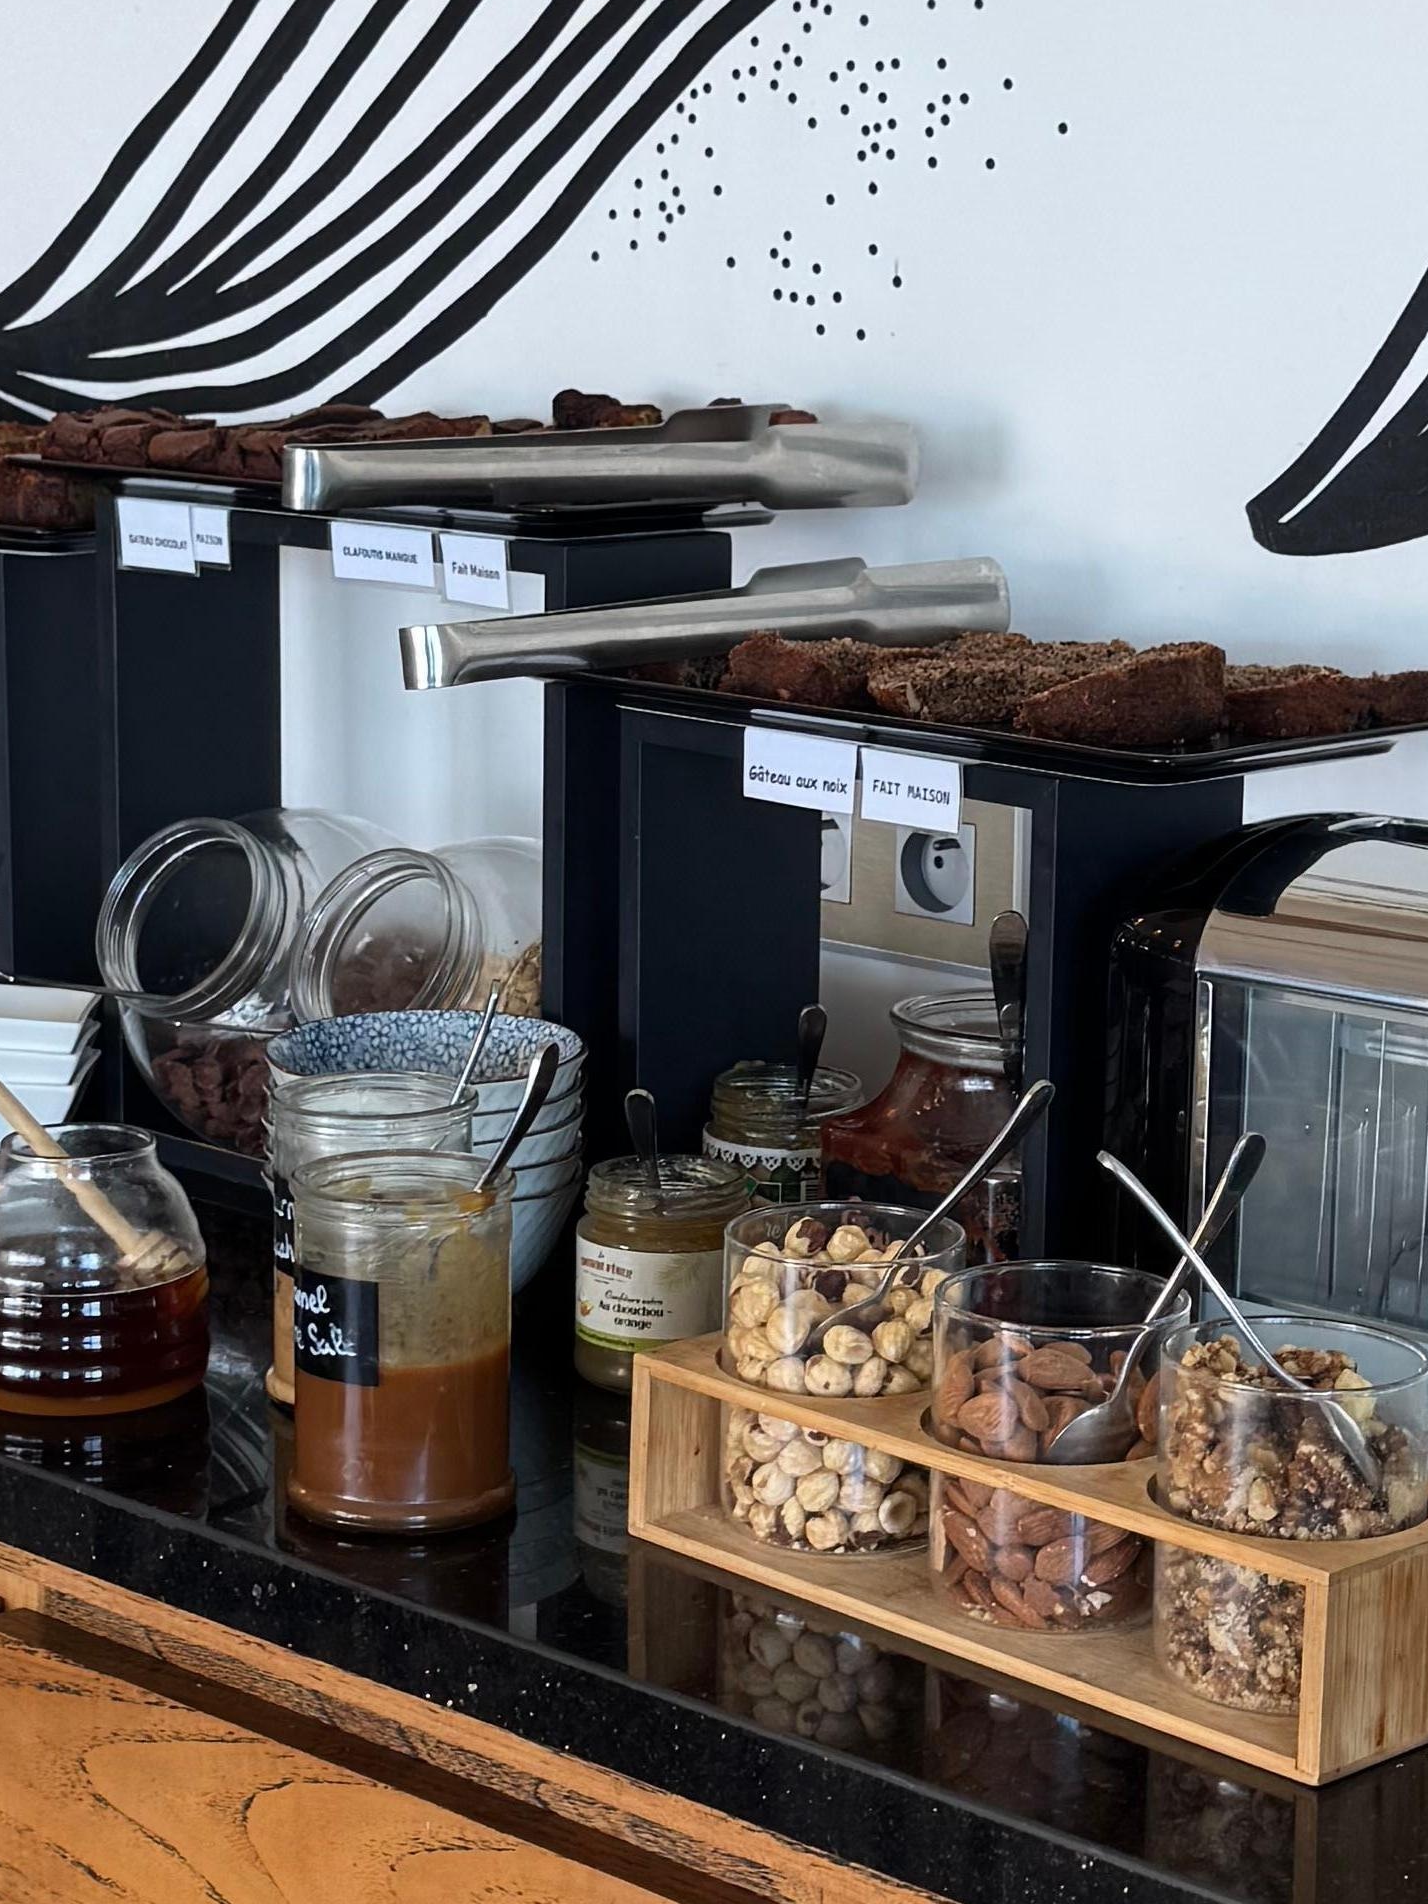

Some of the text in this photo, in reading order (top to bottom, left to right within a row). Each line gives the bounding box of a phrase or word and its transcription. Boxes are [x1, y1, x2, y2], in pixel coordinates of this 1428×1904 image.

[748, 765, 848, 795] Gâteau aux noix
[872, 779, 950, 806] FAIT MAISON
[614, 1316, 652, 1331] orange
